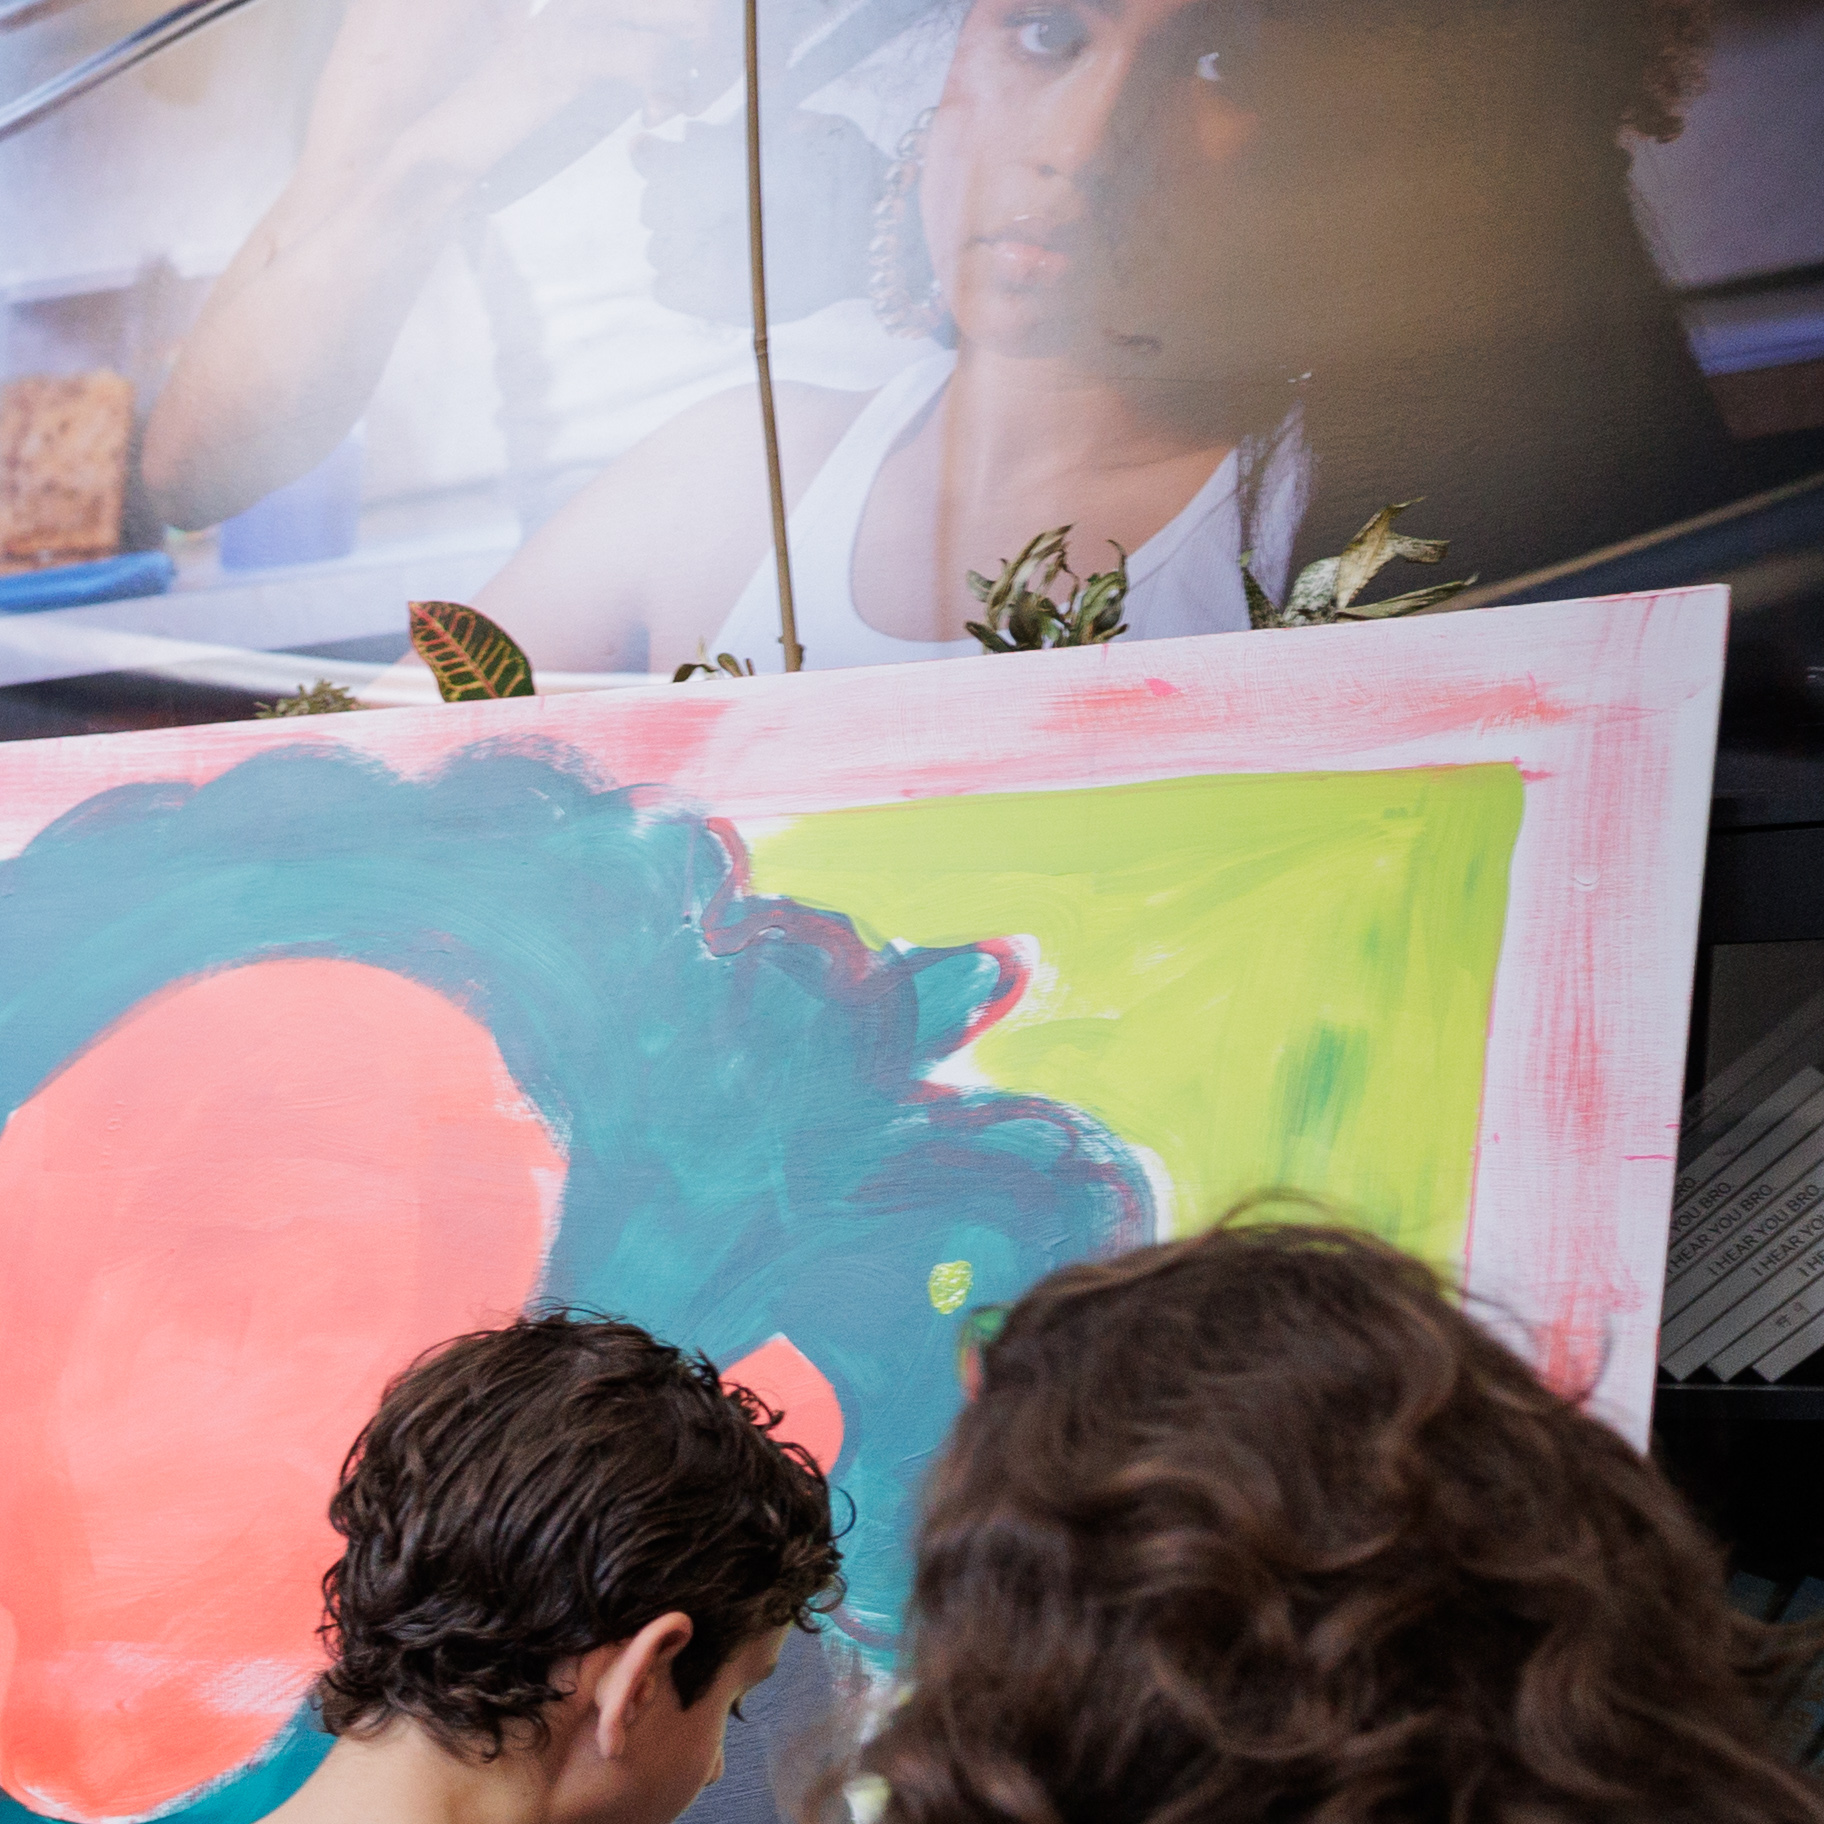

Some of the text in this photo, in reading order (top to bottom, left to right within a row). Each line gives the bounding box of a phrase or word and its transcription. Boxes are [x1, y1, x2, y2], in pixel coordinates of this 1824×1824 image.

[1669, 1233, 1713, 1269] HEAR
[1708, 1209, 1742, 1235] YOU
[1740, 1184, 1773, 1212] BRO
[1671, 1182, 1731, 1233] YOU BRO
[1707, 1184, 1820, 1276] I HEAR YOU BRO
[1751, 1214, 1824, 1277] I HEAR YO
[1797, 1249, 1824, 1277] I HE
